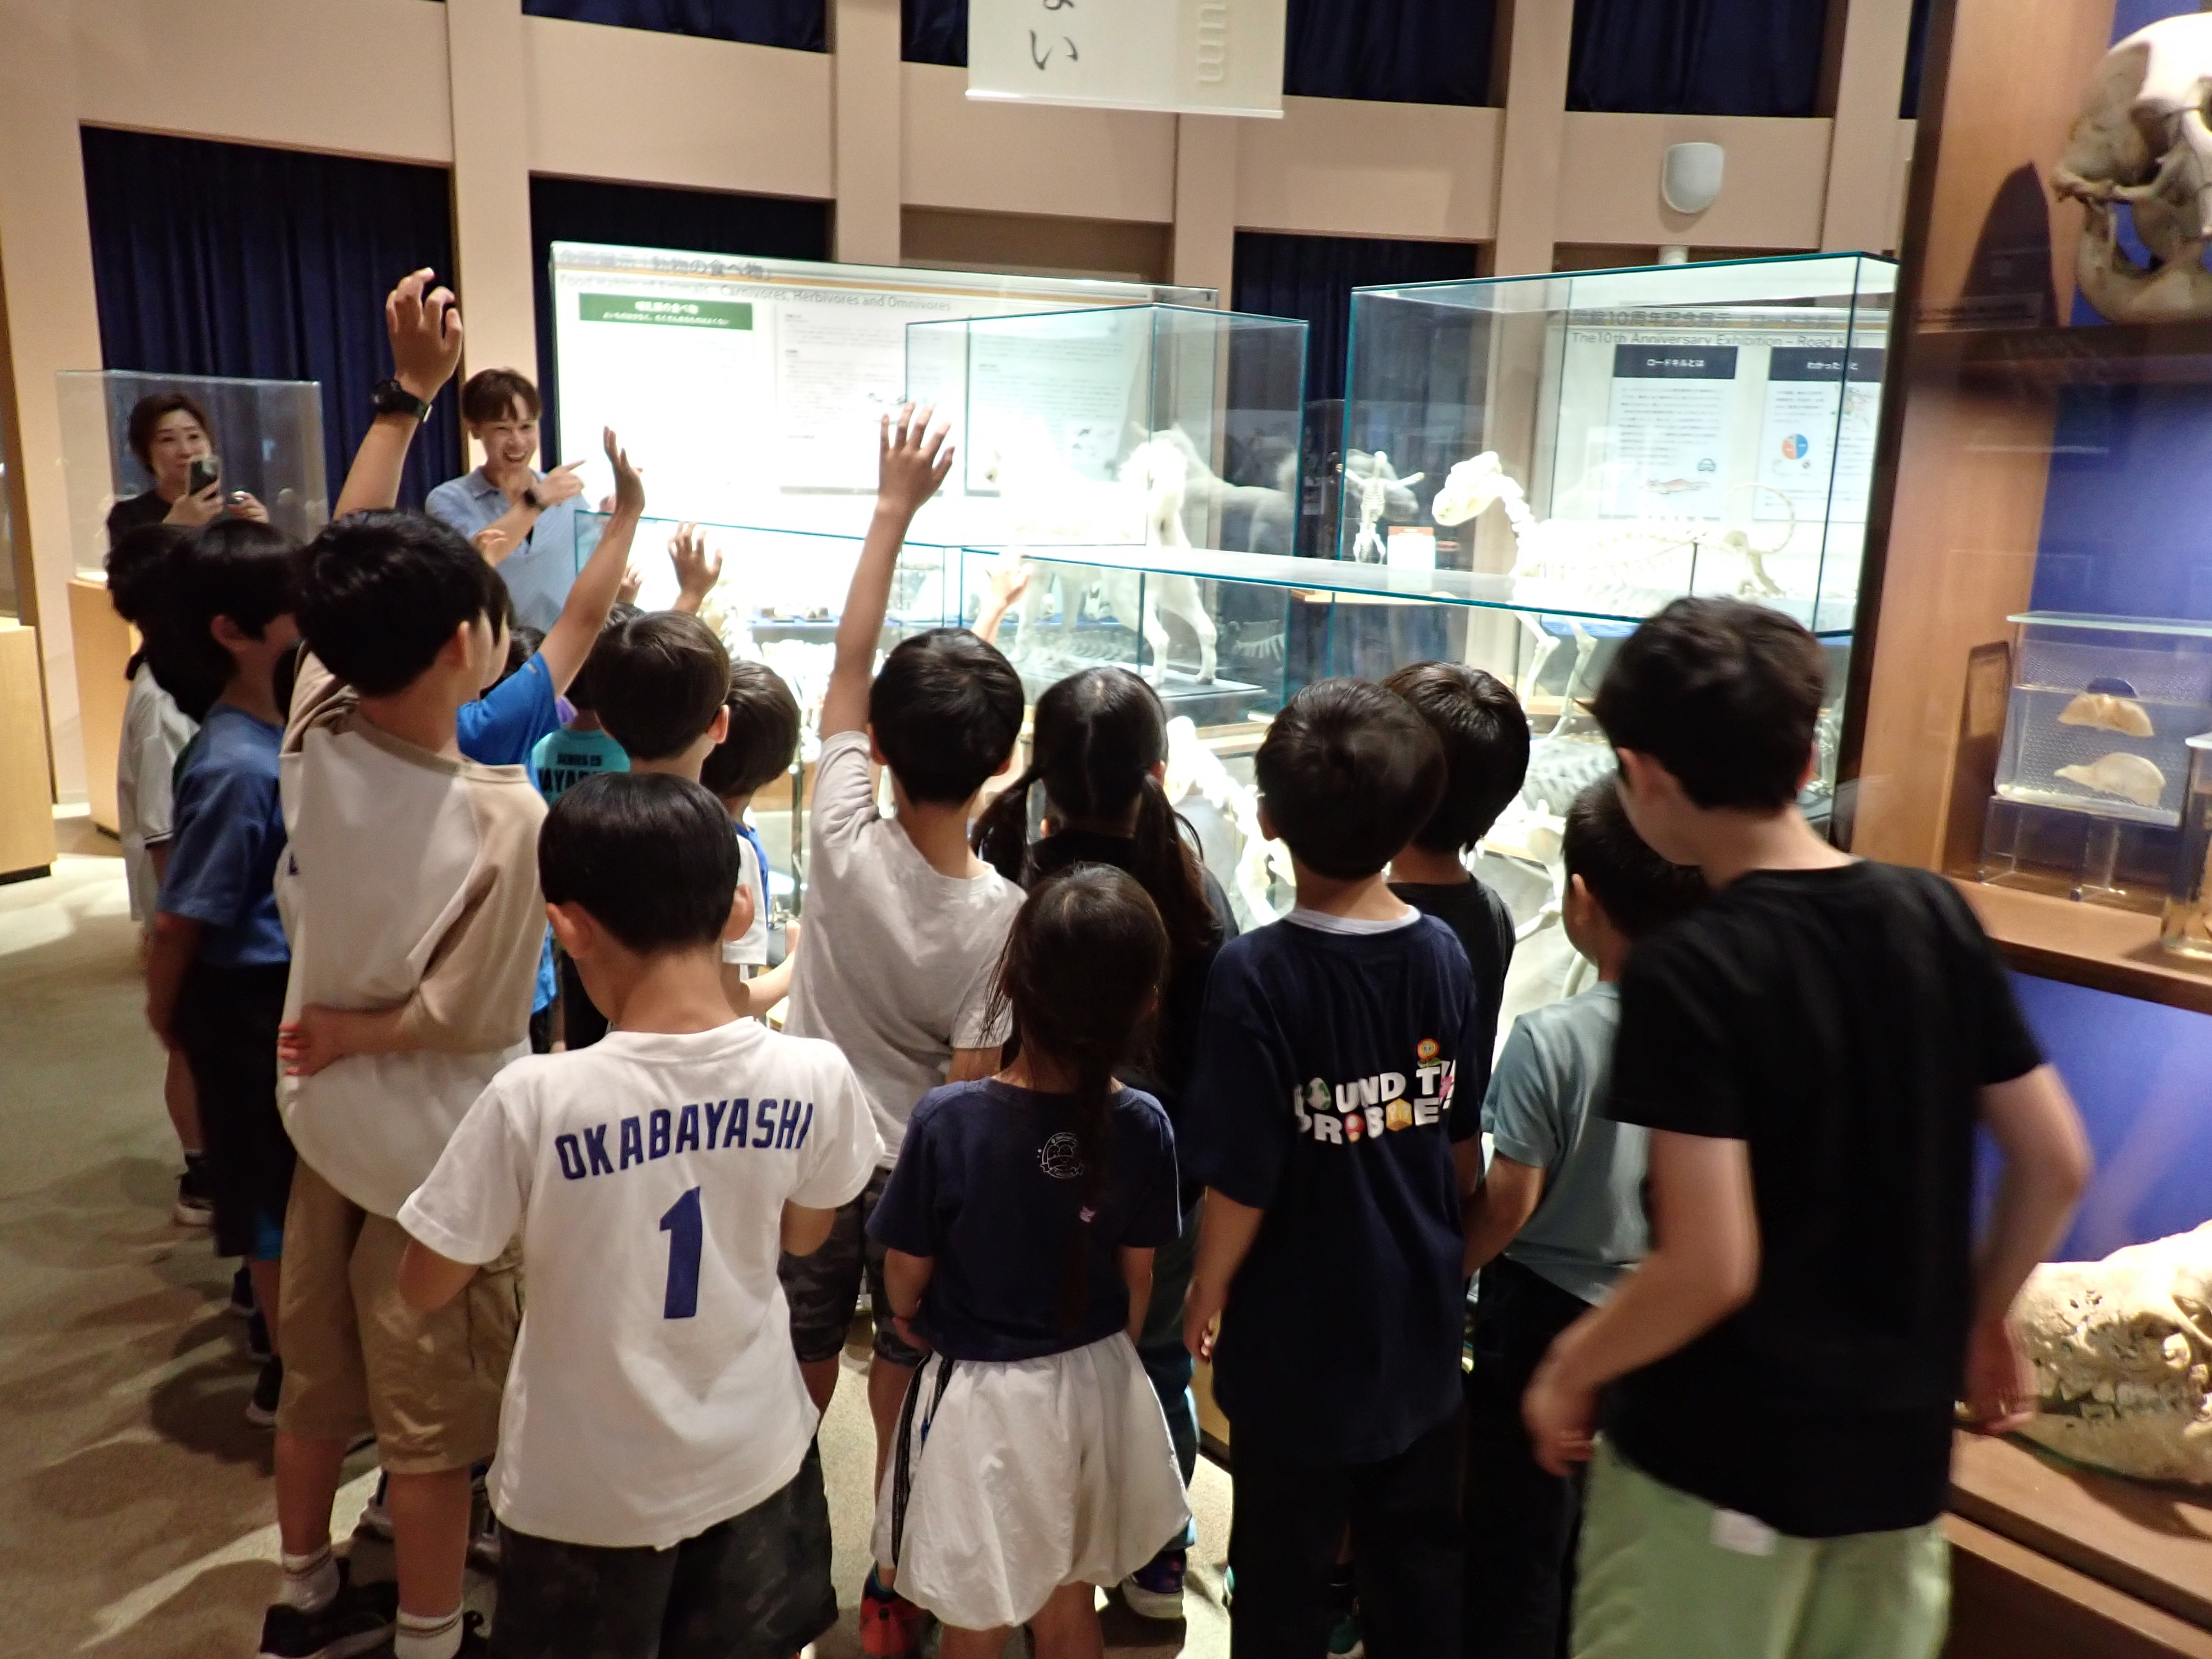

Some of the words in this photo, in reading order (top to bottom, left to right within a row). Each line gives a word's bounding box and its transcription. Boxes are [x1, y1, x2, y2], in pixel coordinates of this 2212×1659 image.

[863, 293, 885, 307] and
[554, 1098, 813, 1180] OKABAYASHI
[660, 1186, 703, 1319] 1
